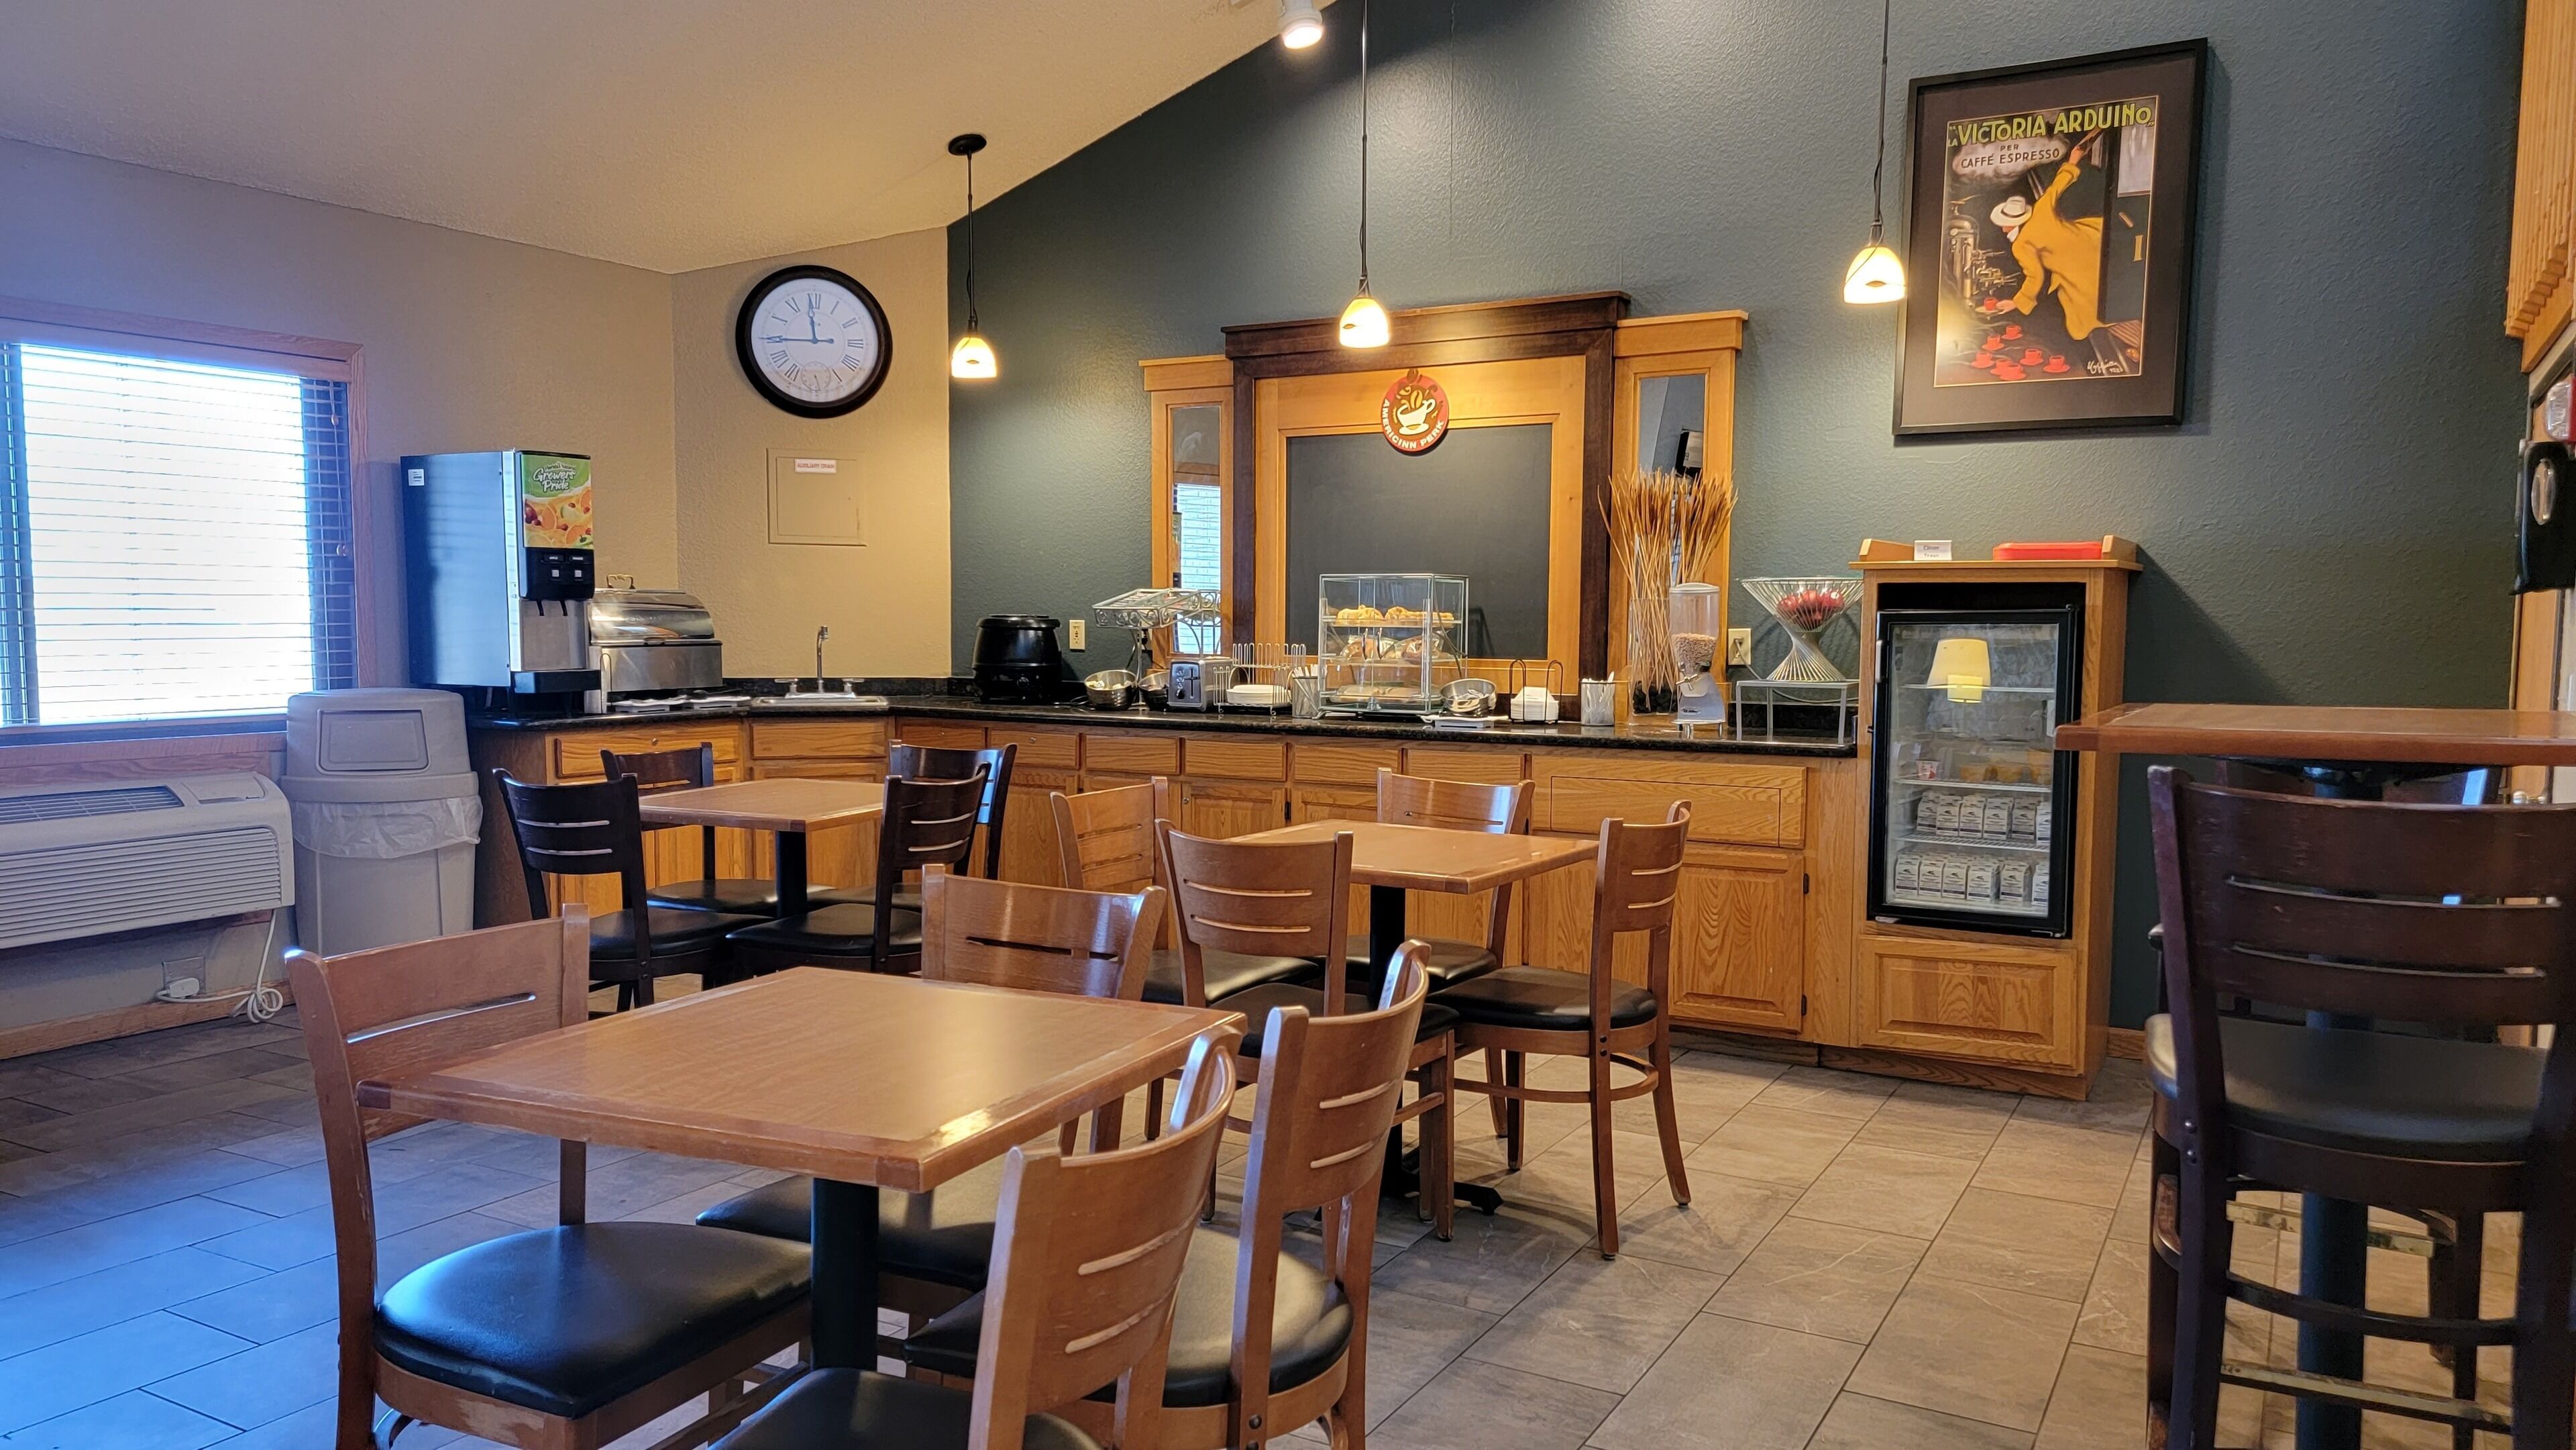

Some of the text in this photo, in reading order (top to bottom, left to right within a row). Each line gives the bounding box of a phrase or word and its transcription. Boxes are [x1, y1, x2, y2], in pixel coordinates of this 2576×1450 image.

[2000, 148, 2060, 164] ESPRESSO
[1382, 399, 1444, 449] AMERICINN PERK
[542, 479, 569, 492] Pride
